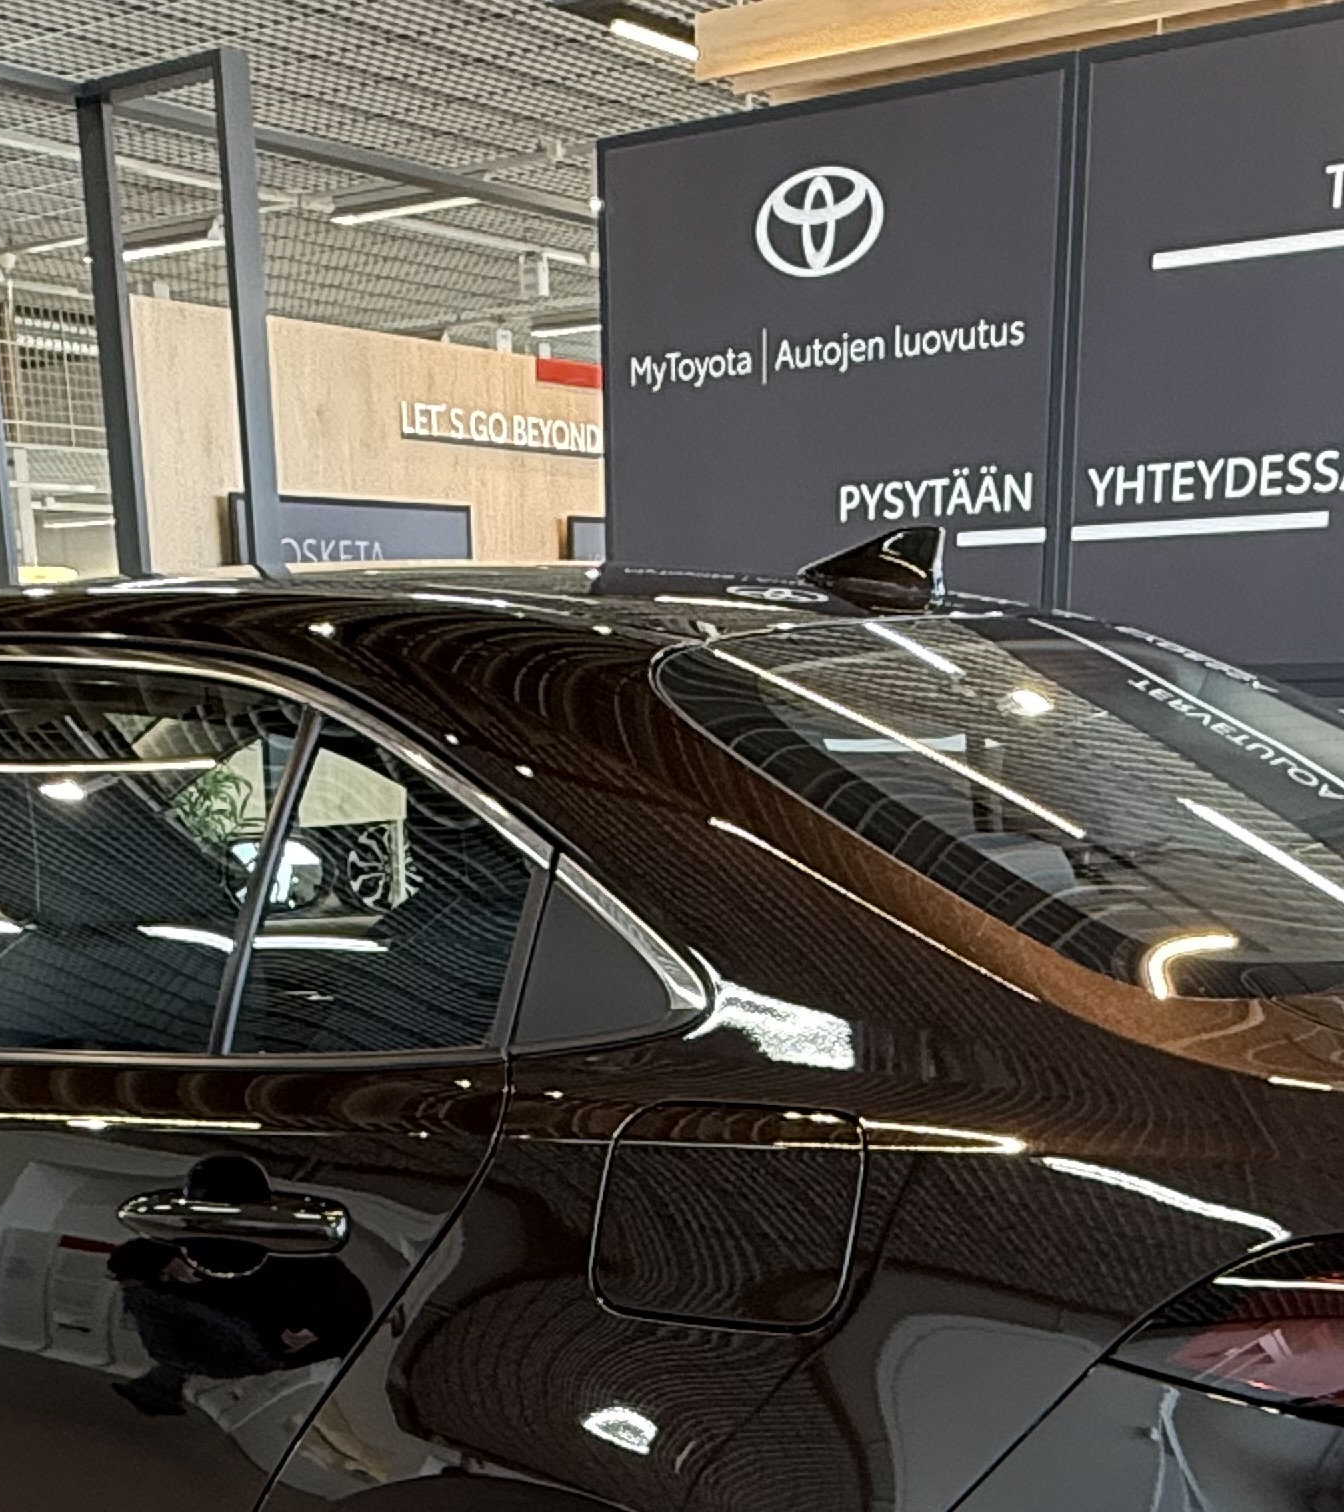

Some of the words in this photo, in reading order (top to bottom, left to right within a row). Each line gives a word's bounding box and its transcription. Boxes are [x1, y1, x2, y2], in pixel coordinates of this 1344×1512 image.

[630, 347, 752, 393] MyToyota
[774, 332, 886, 373] Autojen
[894, 318, 1025, 358] luovutus
[469, 409, 508, 444] GO
[513, 414, 604, 454] BEYOND
[840, 465, 1033, 524] PYSYTÄÄN
